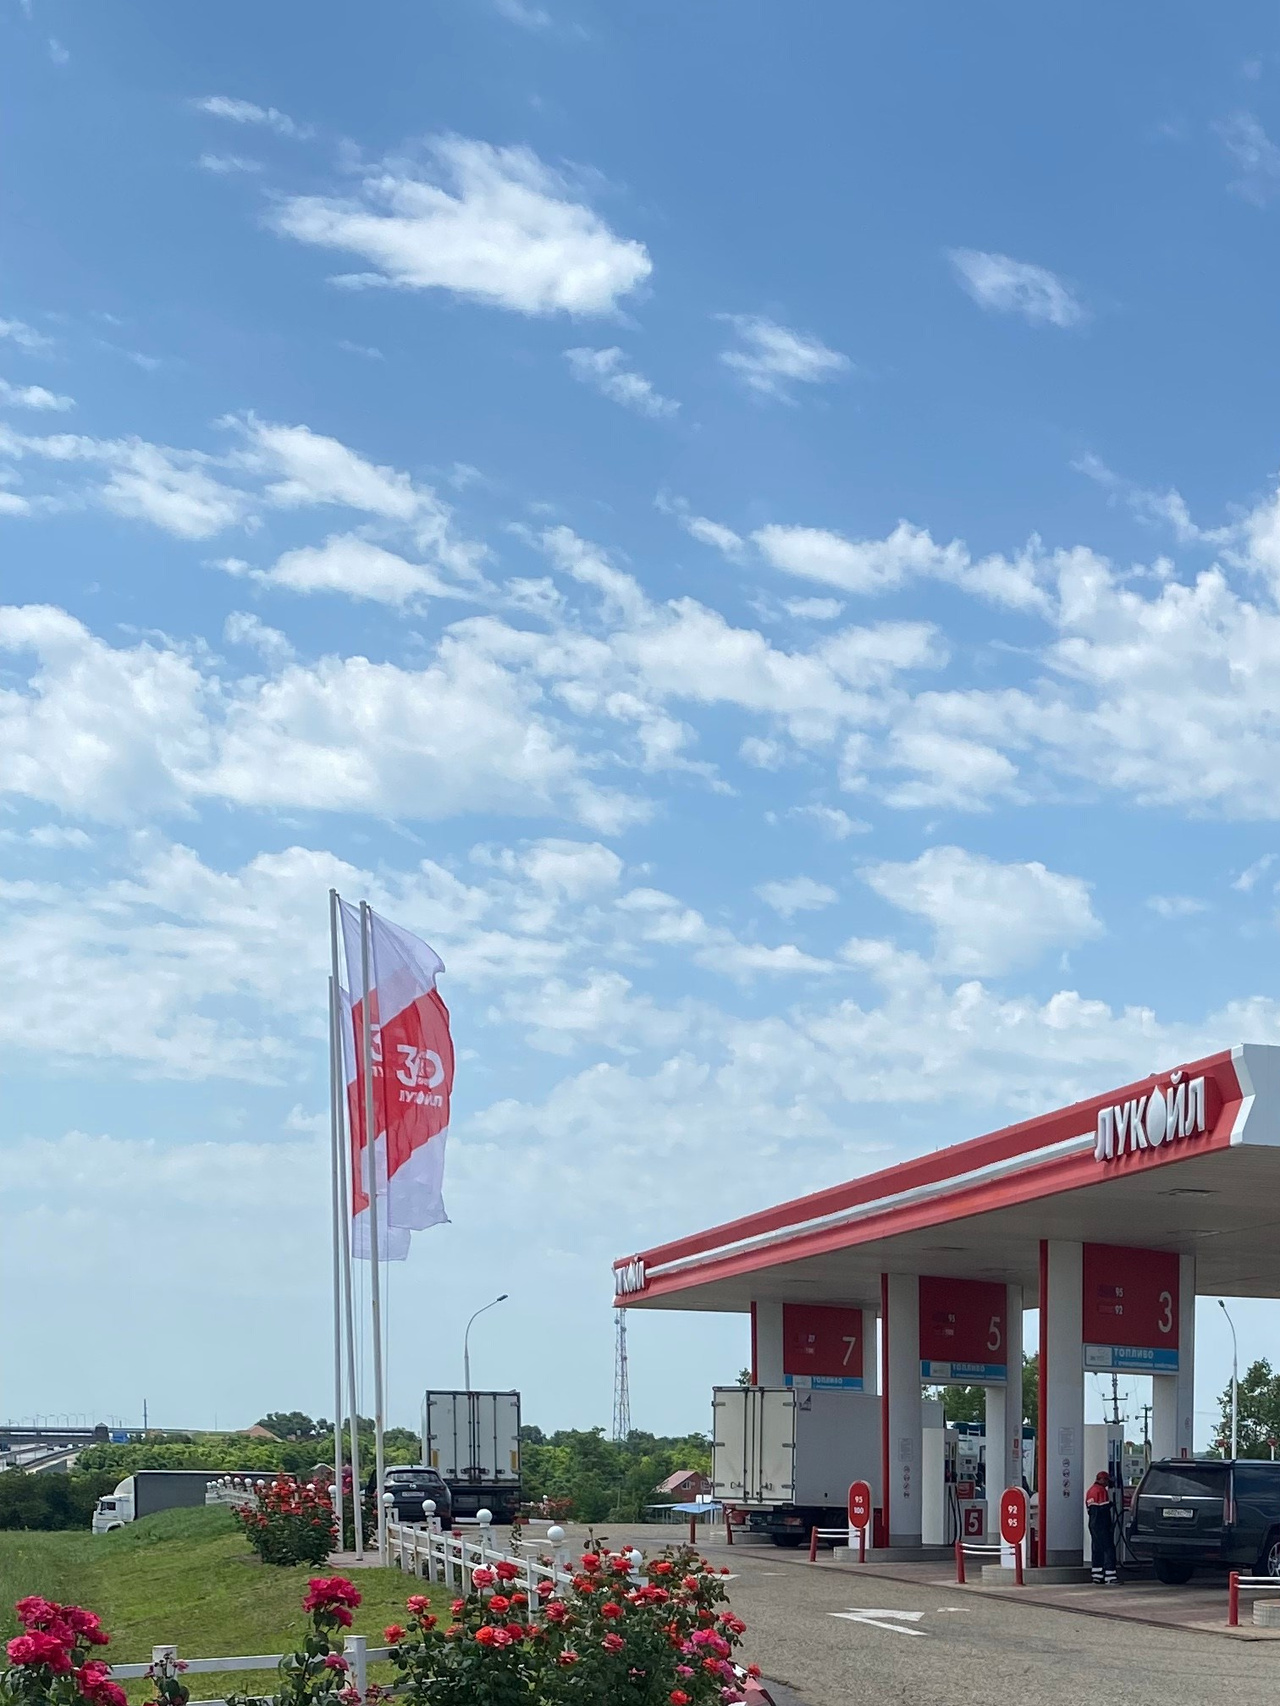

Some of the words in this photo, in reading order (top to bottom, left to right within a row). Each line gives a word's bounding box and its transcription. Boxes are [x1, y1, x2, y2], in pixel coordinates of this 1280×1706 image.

[1094, 1071, 1205, 1163] ЛУКОЙЛ
[1115, 1286, 1124, 1298] 95
[1114, 1305, 1123, 1315] 92
[1158, 1291, 1173, 1333] 3
[987, 1316, 1001, 1351] 5
[842, 1336, 857, 1367] 7
[1114, 1347, 1154, 1359] ТОПЛИВО
[854, 1495, 864, 1503] 95
[853, 1506, 865, 1514] 100
[1007, 1505, 1018, 1514] 92
[968, 1512, 979, 1533] 5
[1007, 1518, 1018, 1527] 95
